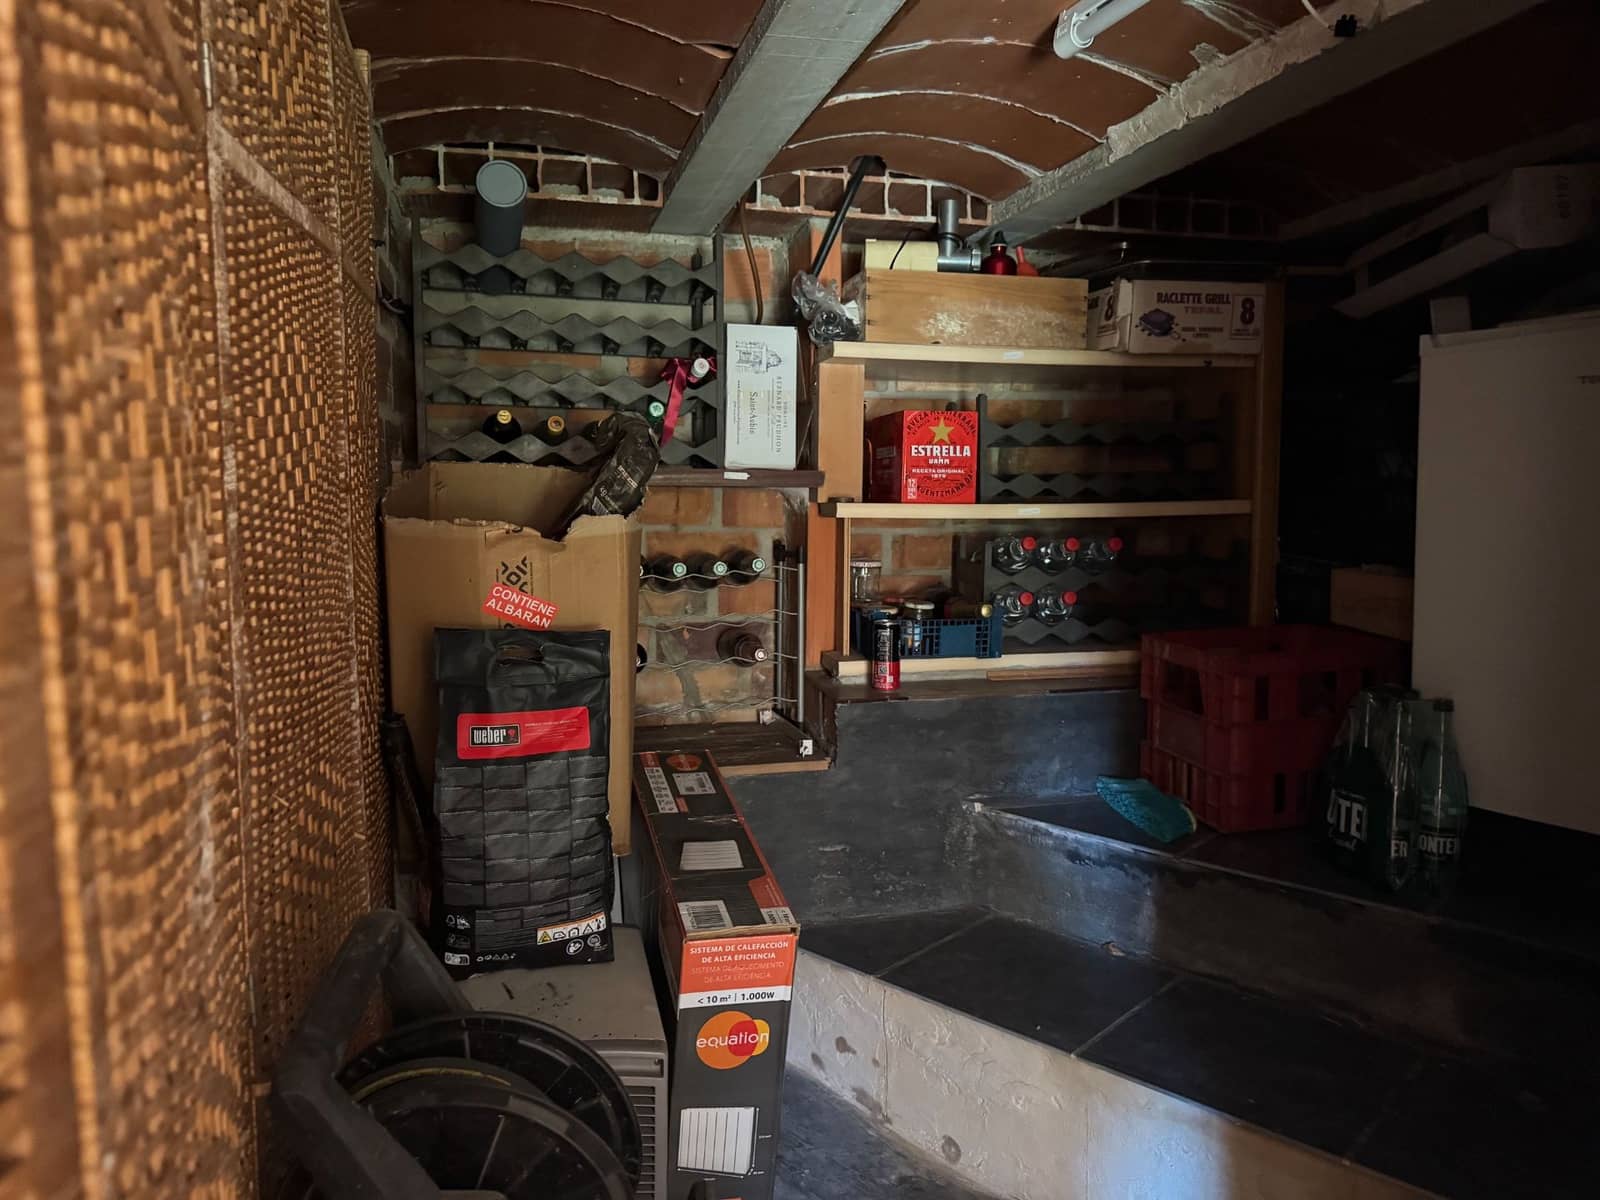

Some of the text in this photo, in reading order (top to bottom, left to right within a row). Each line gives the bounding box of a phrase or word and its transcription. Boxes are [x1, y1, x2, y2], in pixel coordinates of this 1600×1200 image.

[1156, 292, 1231, 304] RACLETTE GRILL
[1240, 296, 1255, 324] 8
[911, 445, 972, 457] ESTRELLA
[928, 457, 950, 465] DAMM
[492, 586, 557, 617] CONTIENE
[486, 598, 552, 629] ALBARAN
[473, 726, 507, 744] weber
[689, 940, 789, 954] SISTEMA DE CALEFACCIÓN
[702, 952, 776, 964] DE ALTA EFICIENCIA
[706, 995, 718, 1003] 10
[741, 991, 775, 1001] 1.000W
[696, 1032, 770, 1048] equation
